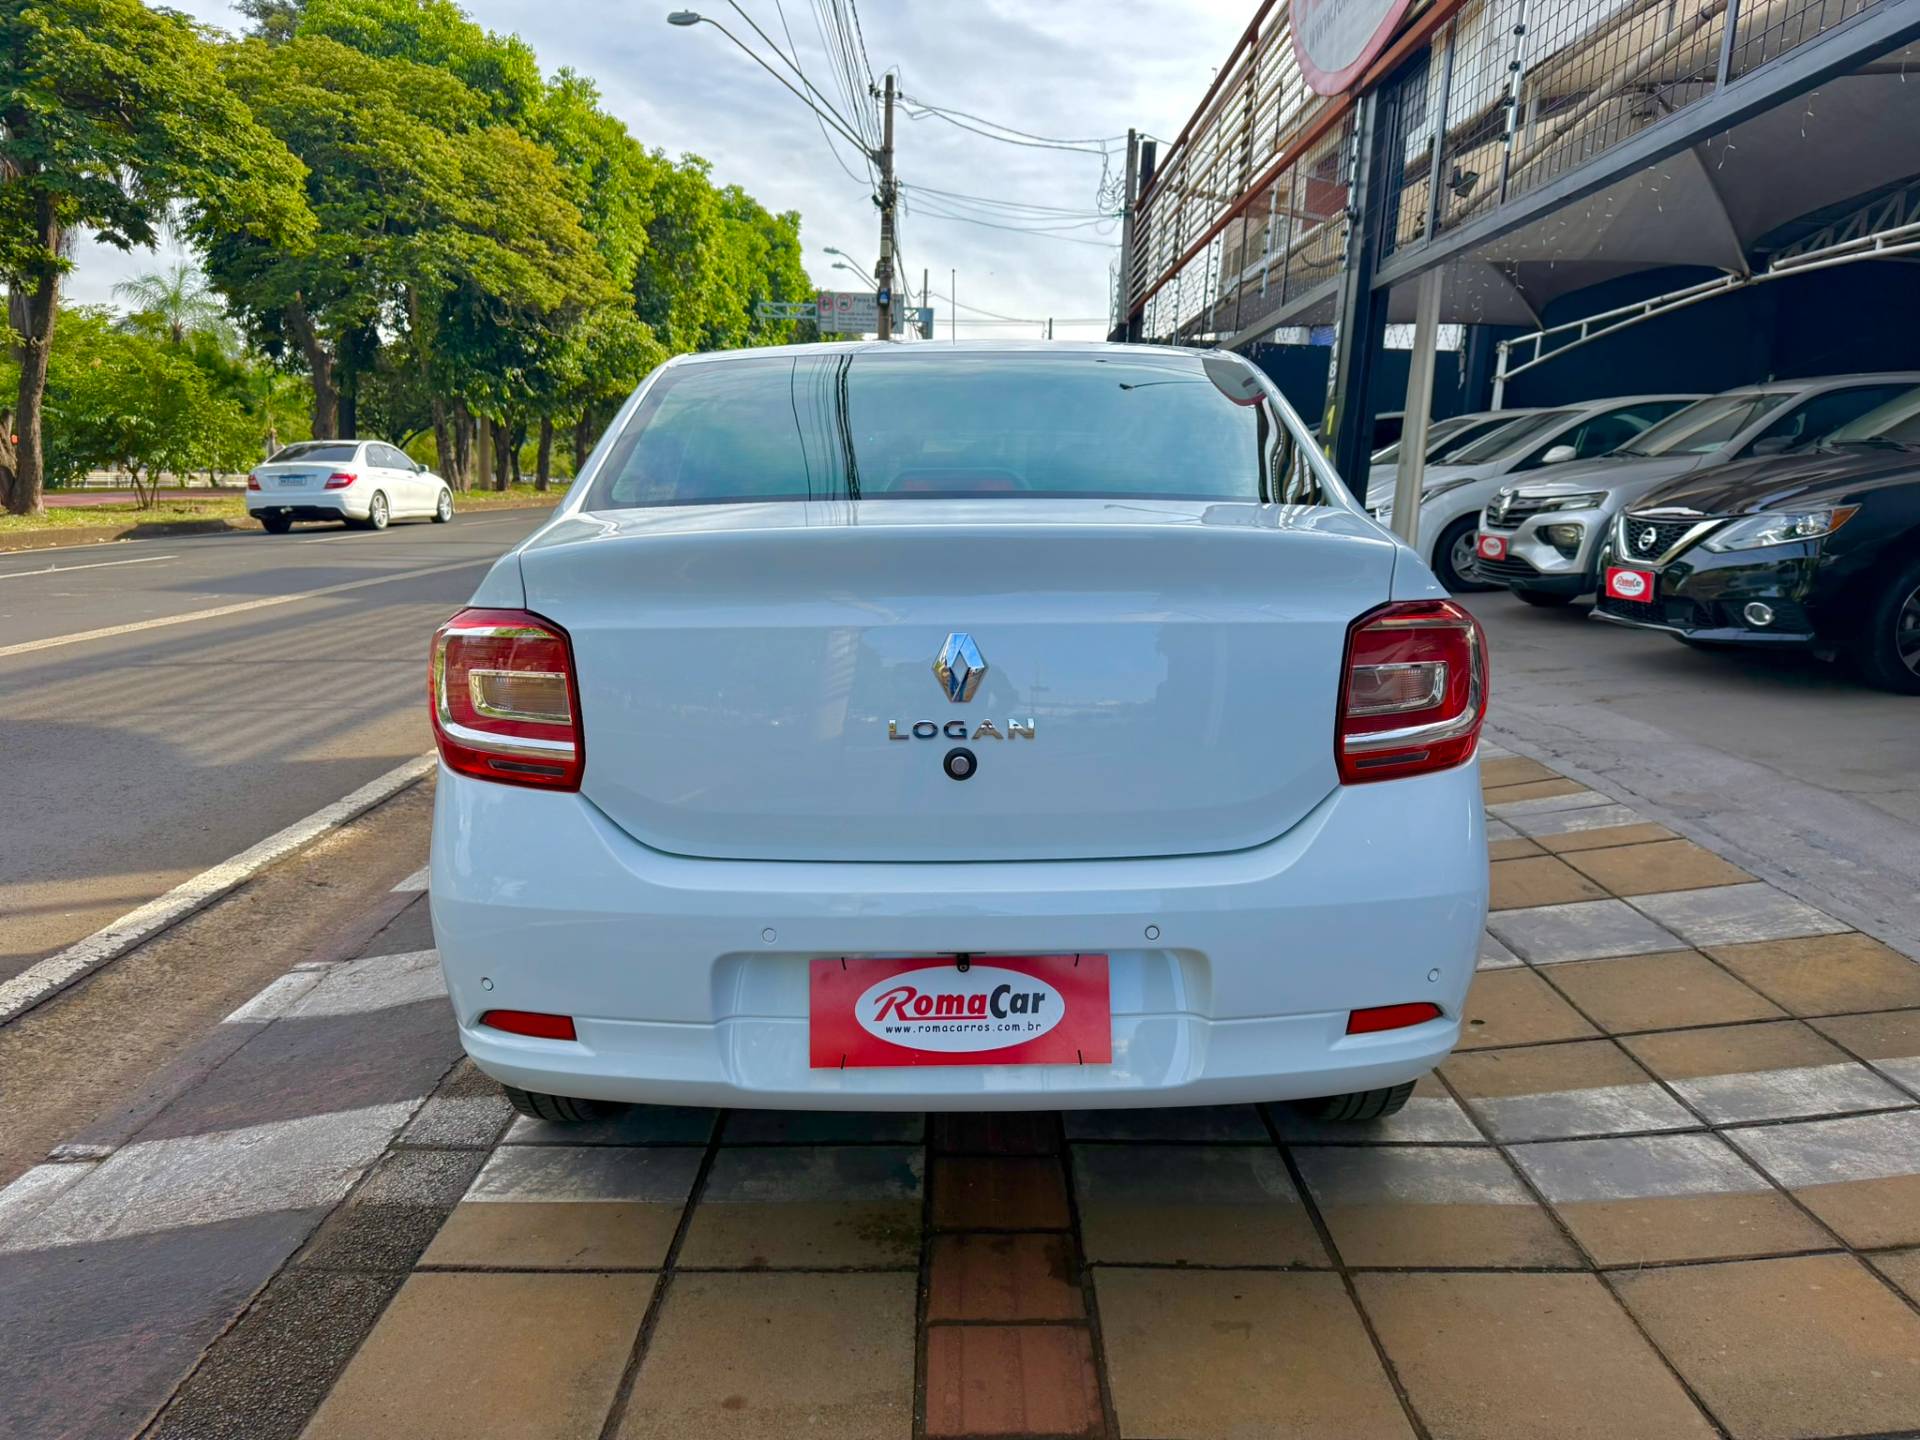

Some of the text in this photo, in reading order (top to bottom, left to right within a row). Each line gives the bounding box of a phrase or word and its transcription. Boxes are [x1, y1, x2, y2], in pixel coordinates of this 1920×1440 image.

[888, 718, 1035, 740] LOGAN
[873, 984, 1046, 1021] RomaCar
[885, 1021, 1042, 1034] www.romacarros.com.br
